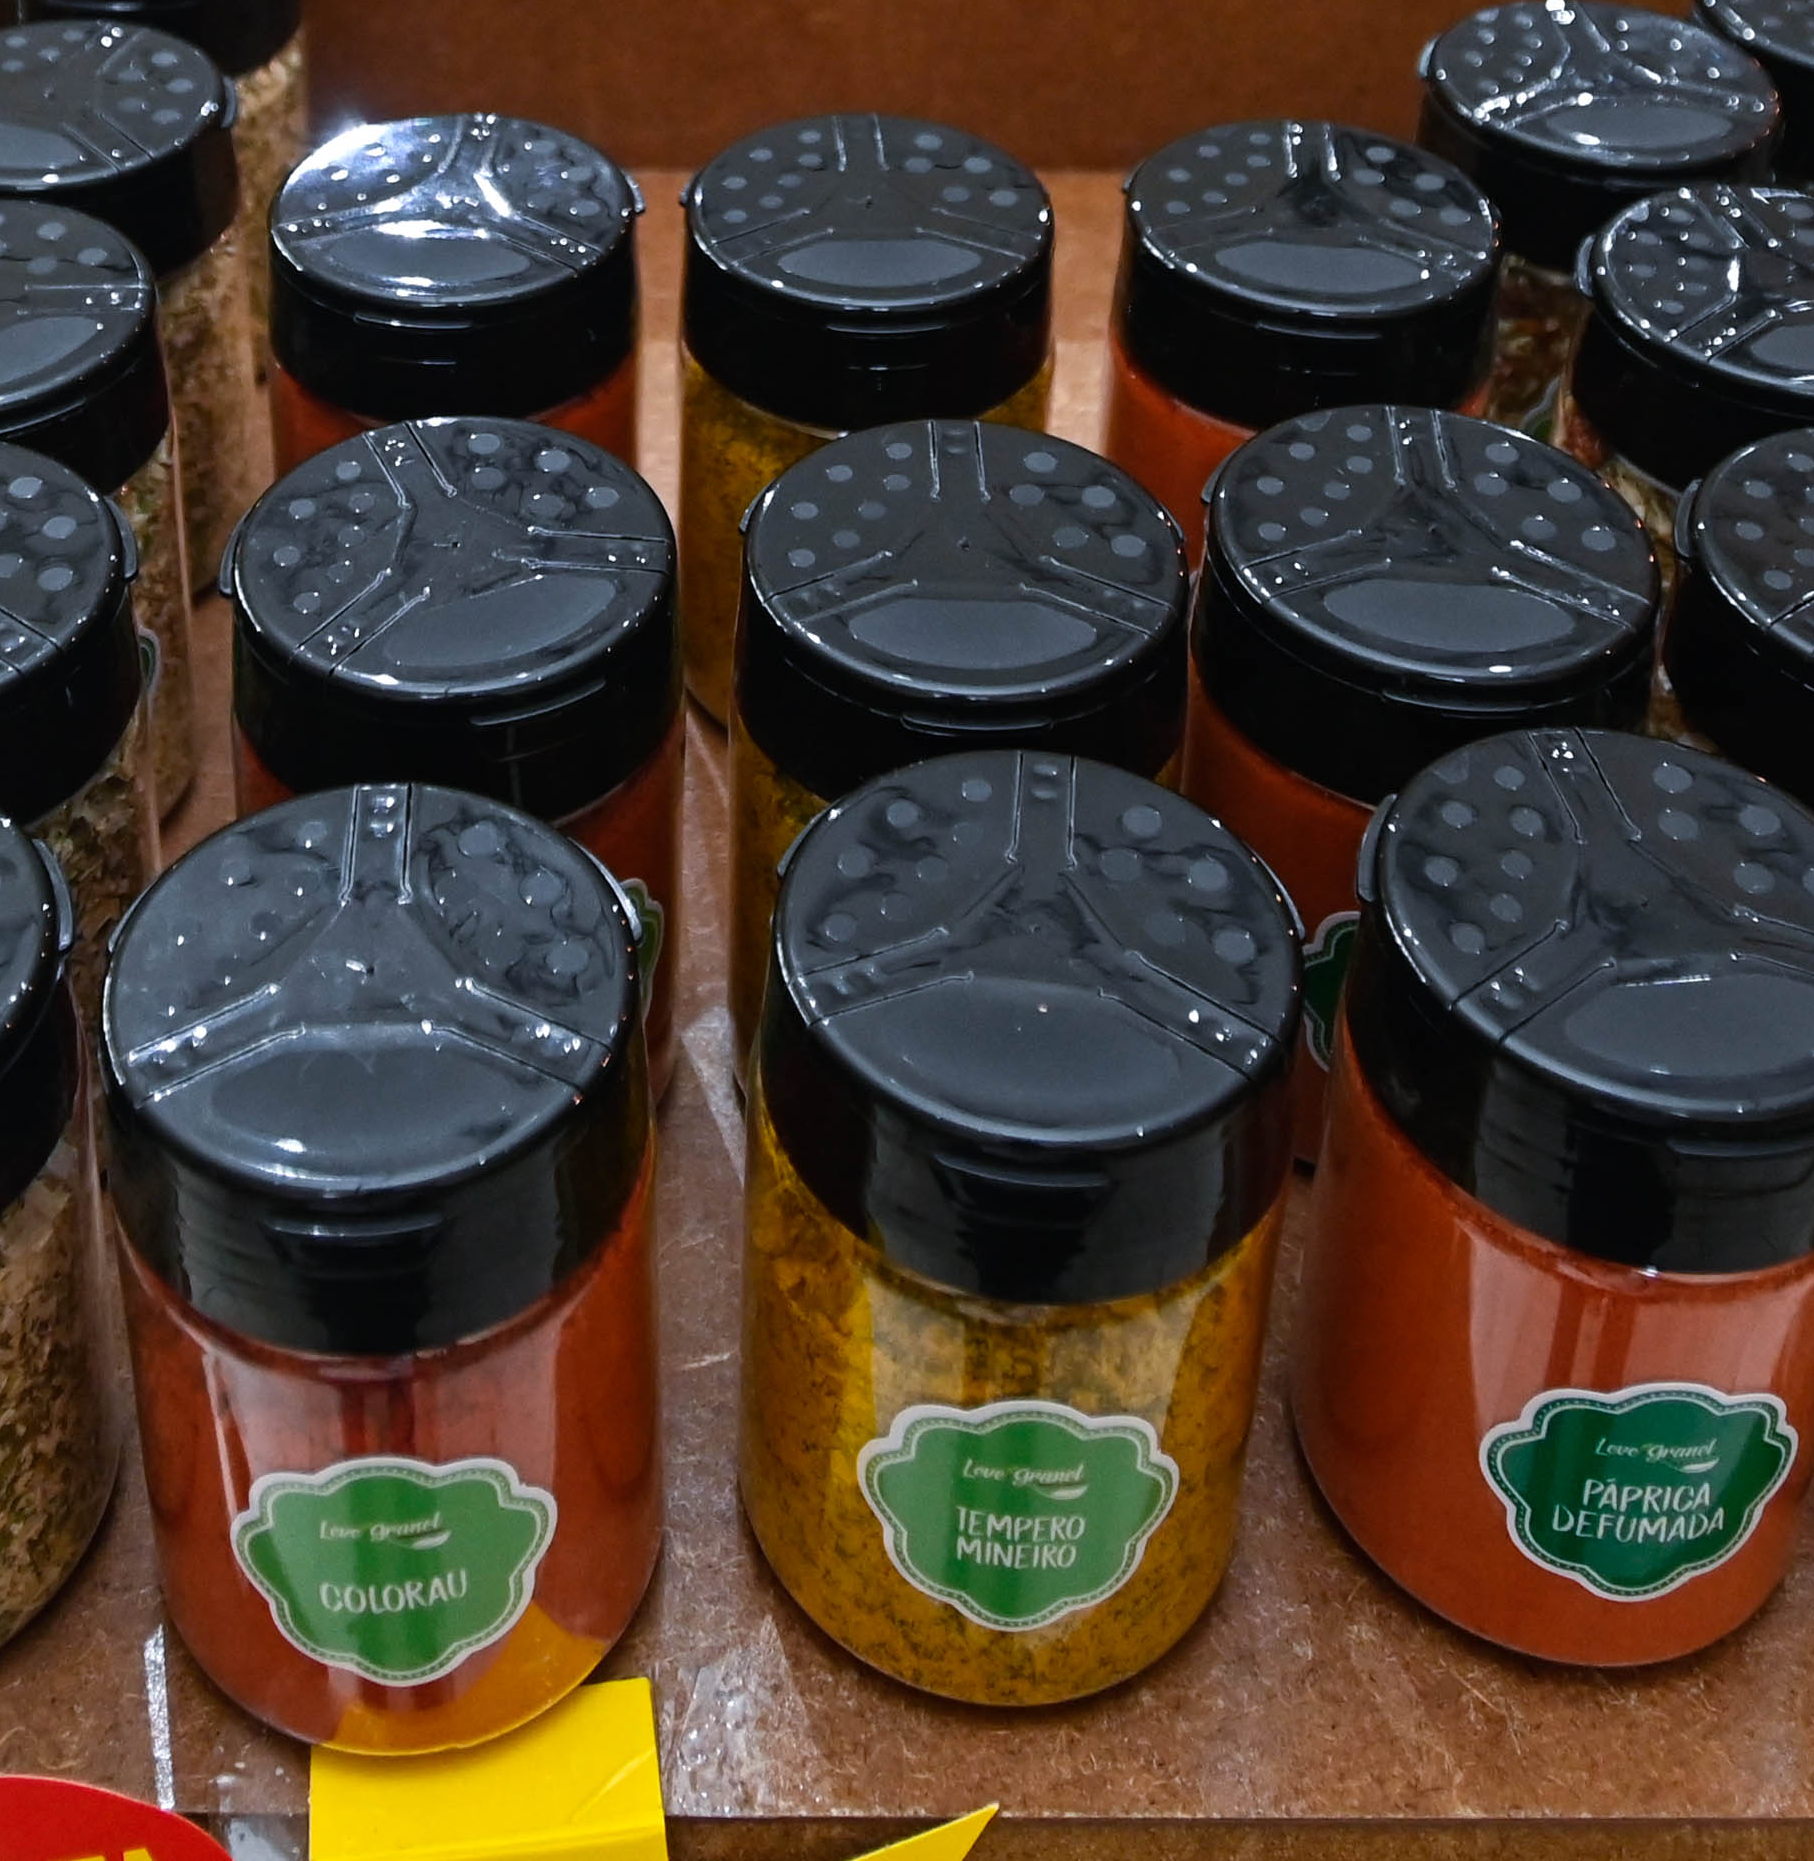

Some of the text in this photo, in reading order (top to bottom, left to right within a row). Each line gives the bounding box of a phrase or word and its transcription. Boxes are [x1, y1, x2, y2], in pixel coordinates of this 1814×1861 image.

[1582, 1477, 1710, 1514] PÁPRICA
[957, 1506, 1085, 1542] TEMPERO
[1552, 1503, 1725, 1544] DEFUMADA
[956, 1536, 1077, 1570] MINEIRO
[319, 1568, 468, 1615] COLORAU
